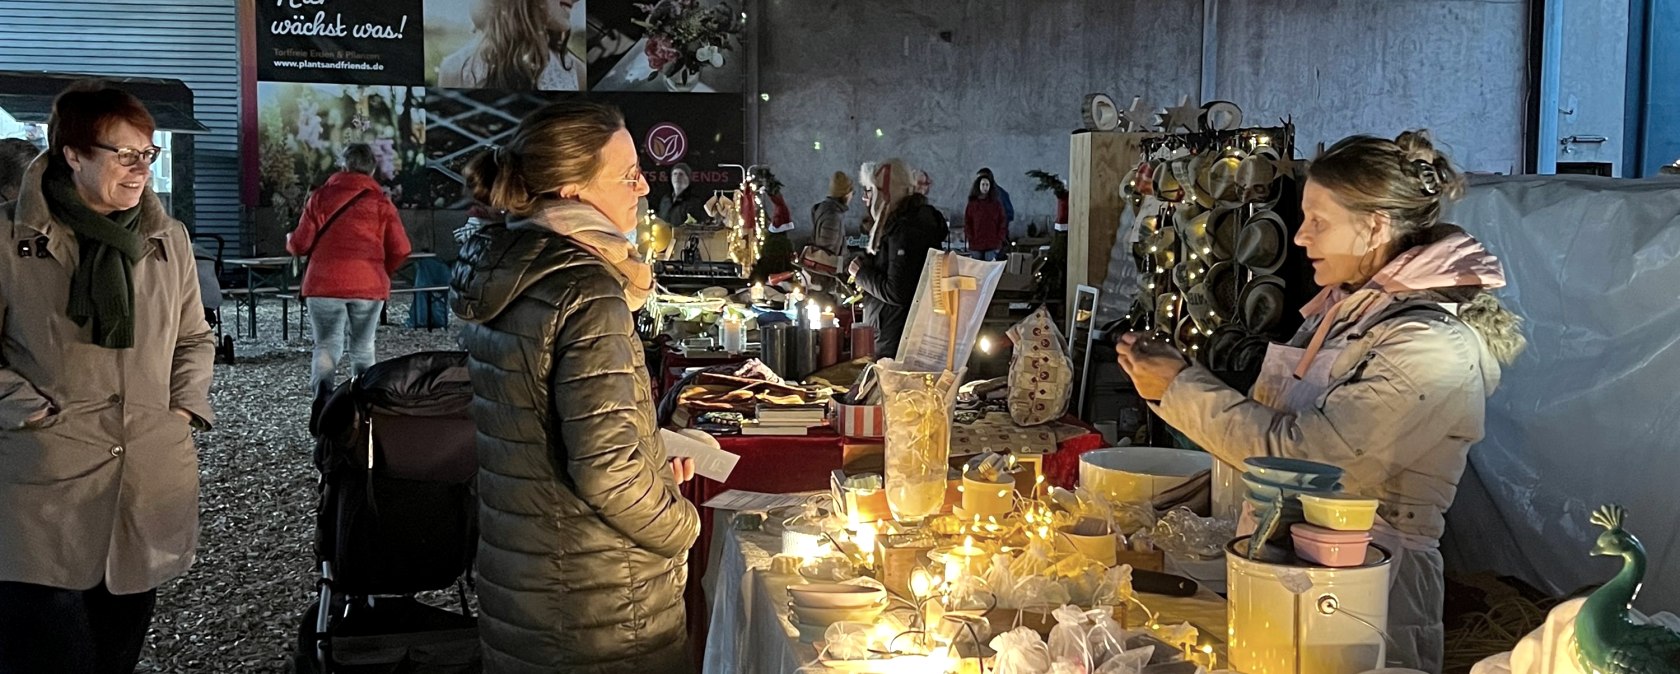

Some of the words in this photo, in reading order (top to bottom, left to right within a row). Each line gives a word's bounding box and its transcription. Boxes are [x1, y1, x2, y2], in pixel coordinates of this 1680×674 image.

[271, 11, 347, 37] wächst
[352, 15, 408, 39] was!
[273, 60, 385, 71] www.plantsandfriends.de
[658, 171, 669, 182] &
[691, 171, 729, 183] ENDS
